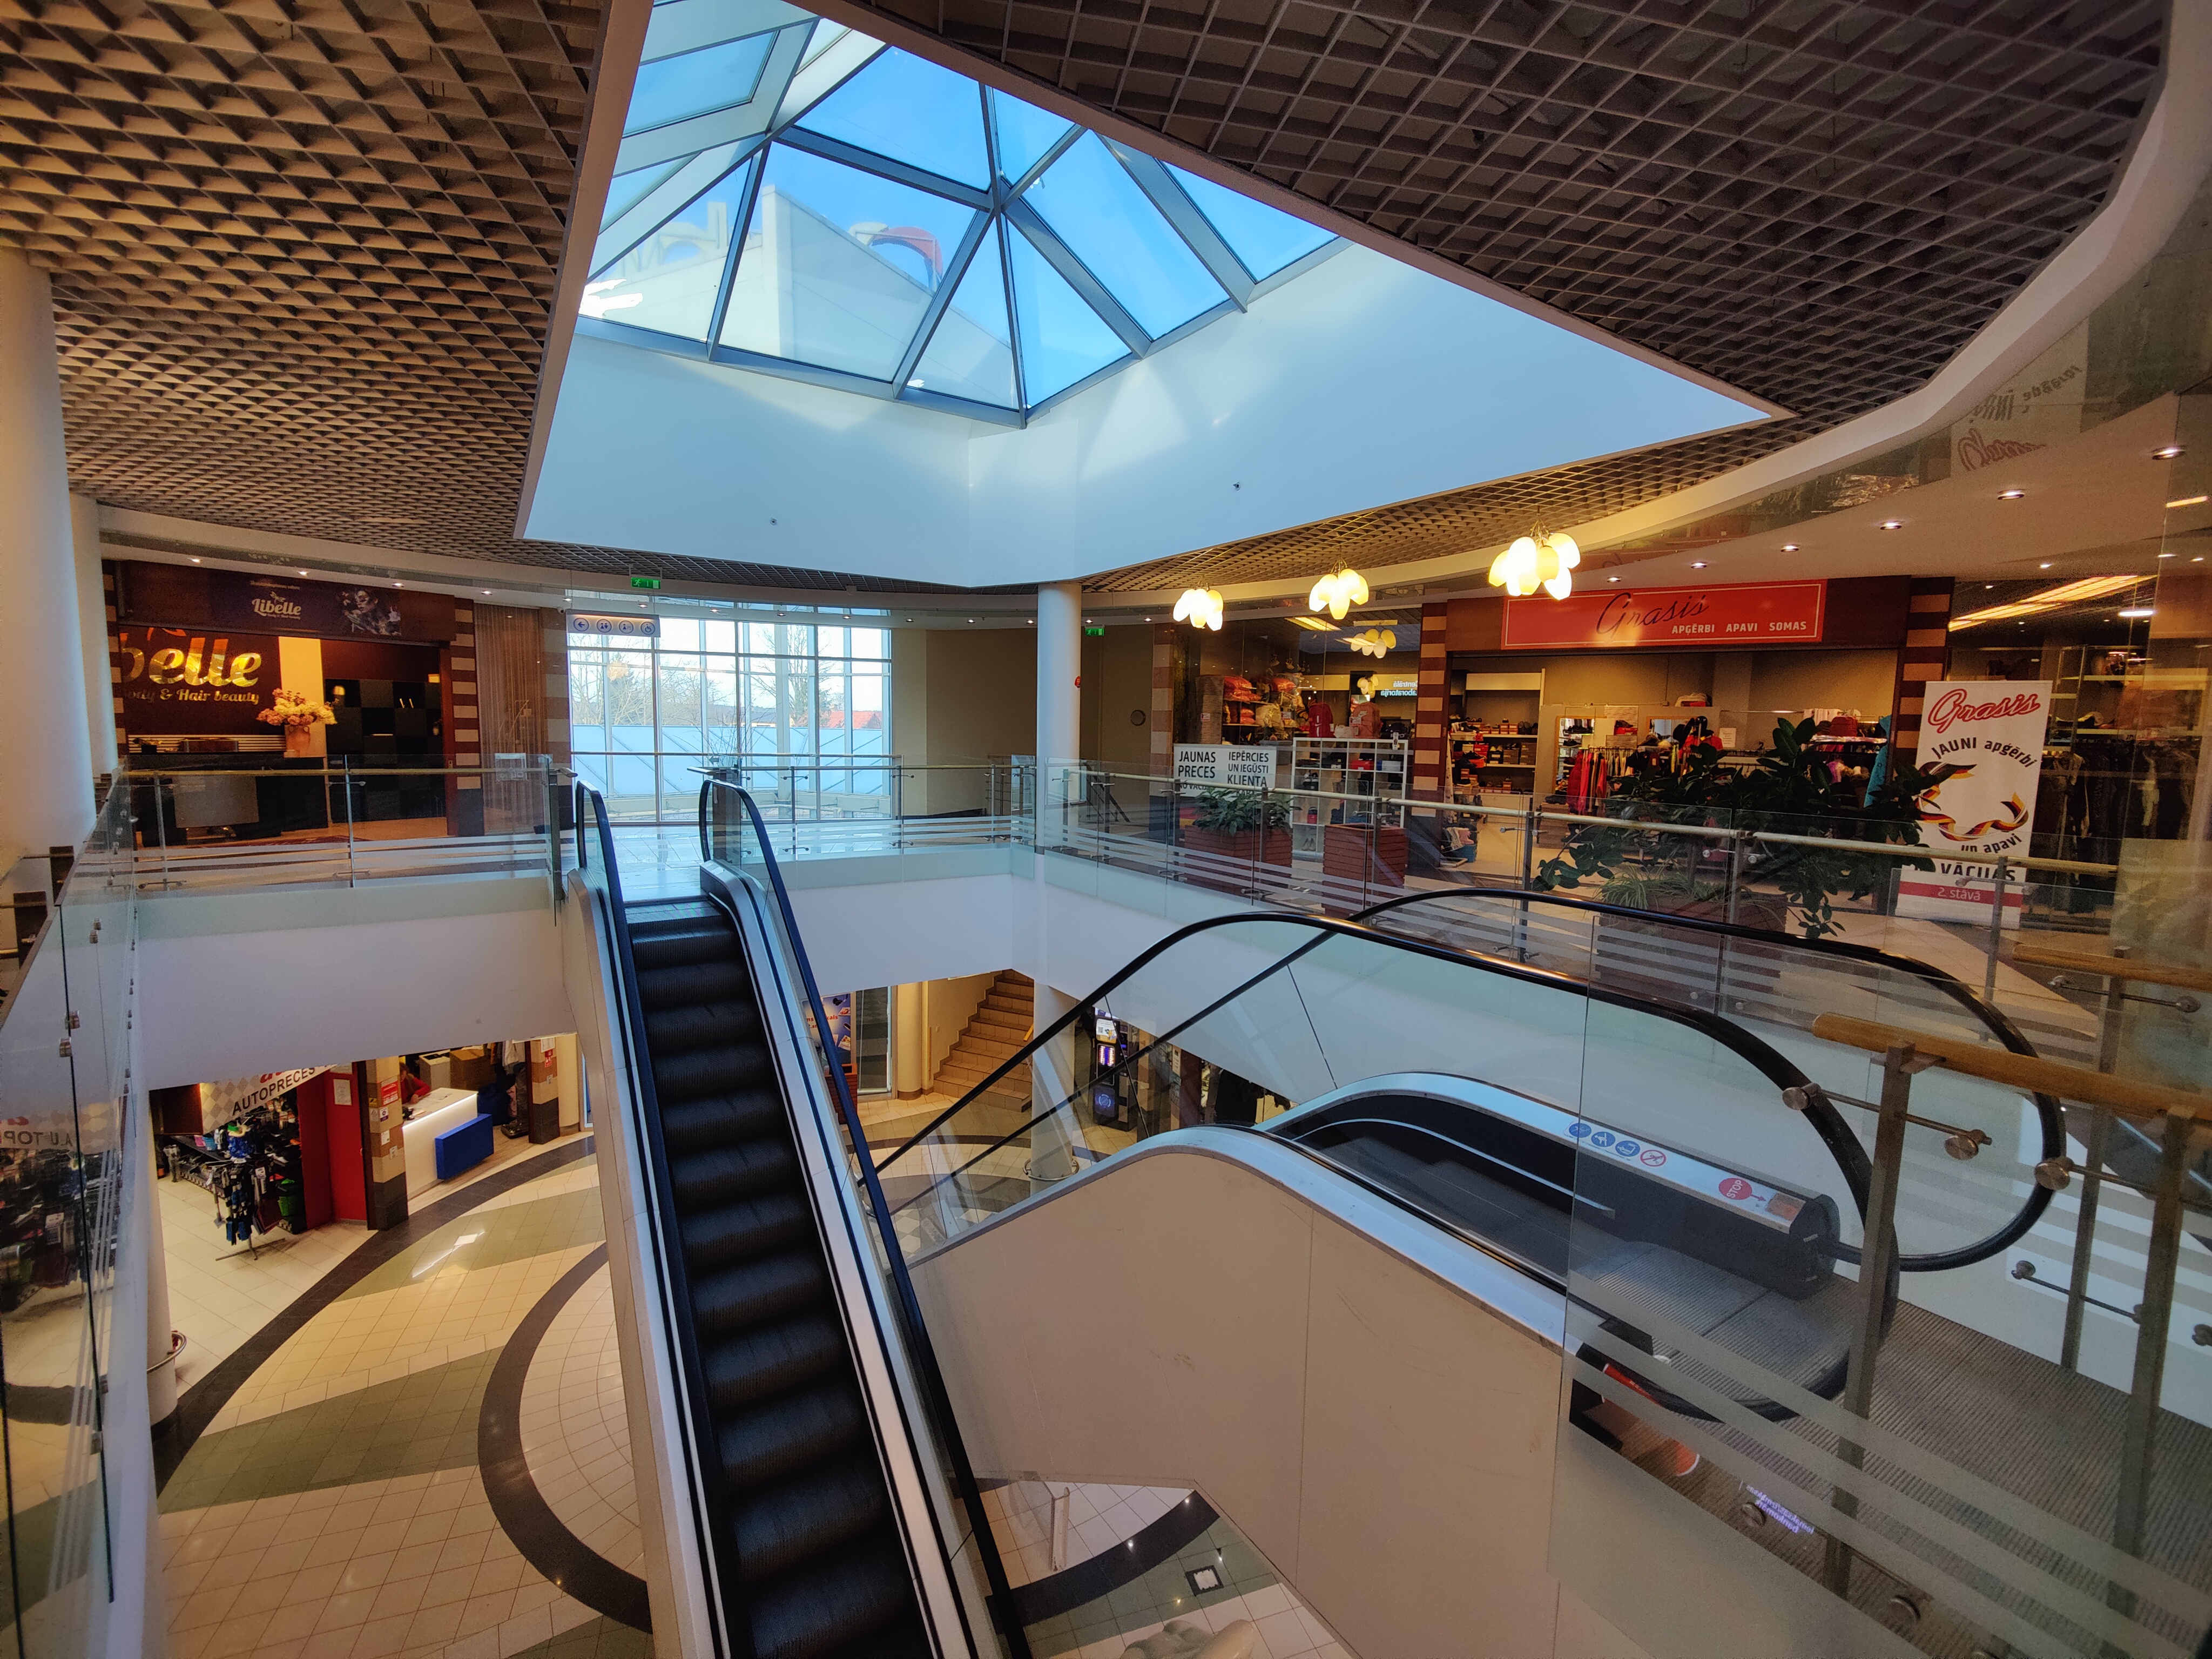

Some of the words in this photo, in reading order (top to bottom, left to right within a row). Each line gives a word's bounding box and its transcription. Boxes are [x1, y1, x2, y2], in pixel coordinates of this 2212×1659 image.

[251, 598, 302, 617] Libelle
[1596, 592, 1709, 639] Grasis
[1672, 622, 1715, 636] APĢĒRBI
[1726, 623, 1758, 632] APAVI
[1769, 621, 1807, 631] SOMAS
[160, 689, 173, 700] &
[176, 689, 211, 701] Hair
[213, 690, 259, 705] beauty
[1928, 689, 2041, 733] Grasis
[1179, 751, 1216, 763] JAUNAS
[1229, 751, 1269, 762] IEPĒRCIES
[1931, 737, 1977, 759] JAUNI
[1984, 740, 2038, 767] apģērbi
[1178, 765, 1215, 778] PRECES
[1228, 764, 1239, 772] UN
[1240, 763, 1269, 773] IEGŪSTI
[1227, 774, 1267, 787] KLIENTA
[1983, 833, 2022, 853] apavi
[1937, 887, 1946, 897] 2
[1950, 889, 1981, 901] stāvā
[232, 1067, 315, 1116] AUTOPRECES
[1727, 1179, 1743, 1198] STOP
